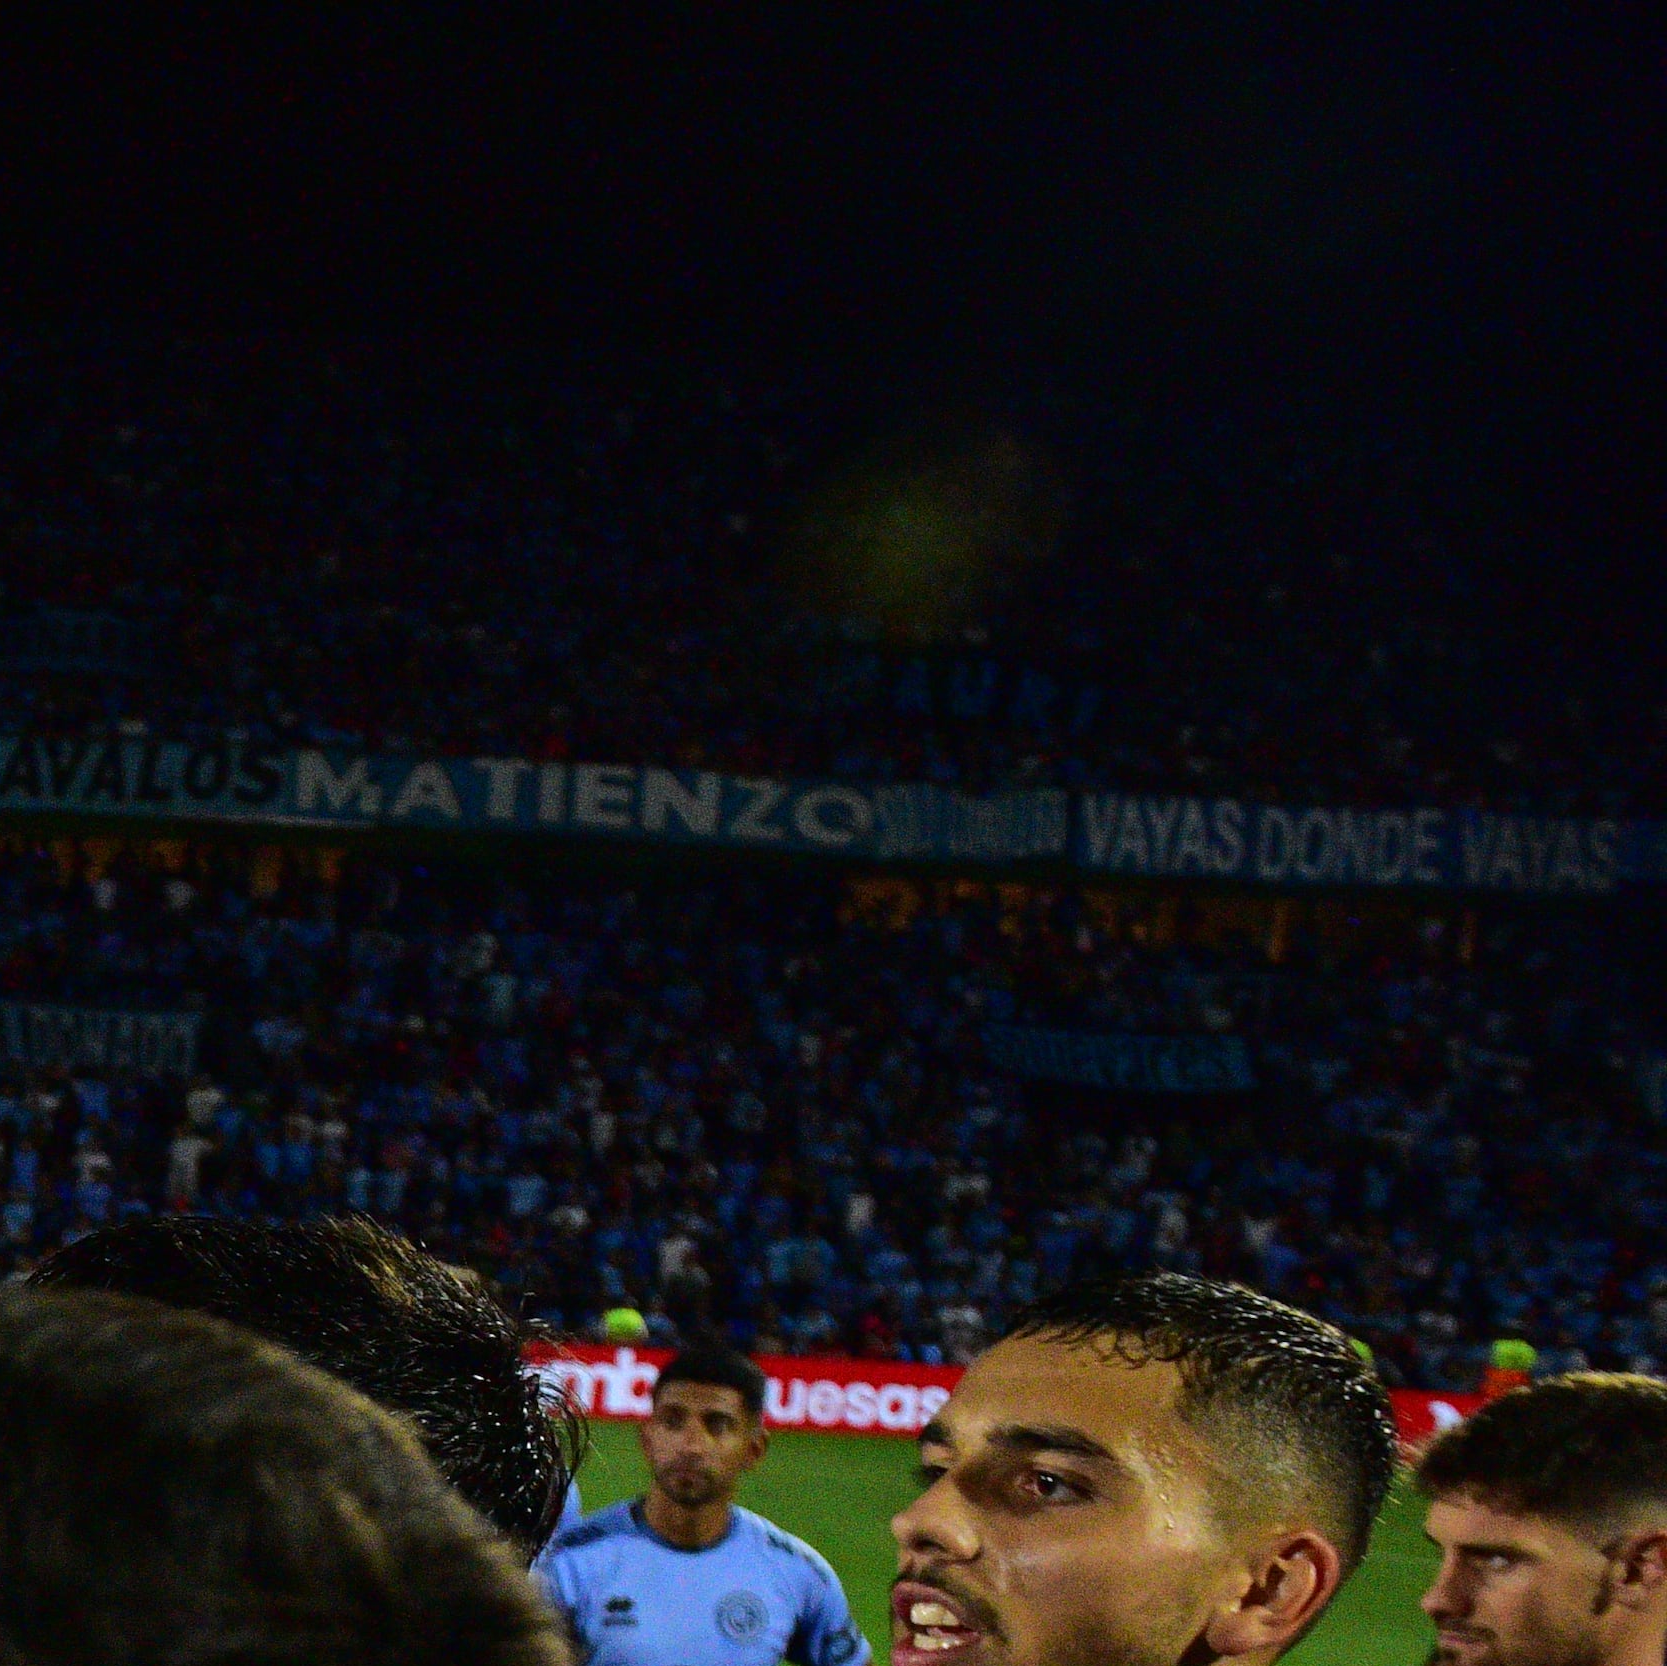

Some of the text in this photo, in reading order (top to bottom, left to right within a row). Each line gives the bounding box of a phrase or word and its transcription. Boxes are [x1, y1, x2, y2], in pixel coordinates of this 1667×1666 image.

[293, 748, 873, 848] MATIENZO
[1081, 795, 1244, 874] VAYAS
[1256, 806, 1445, 884] DONDE
